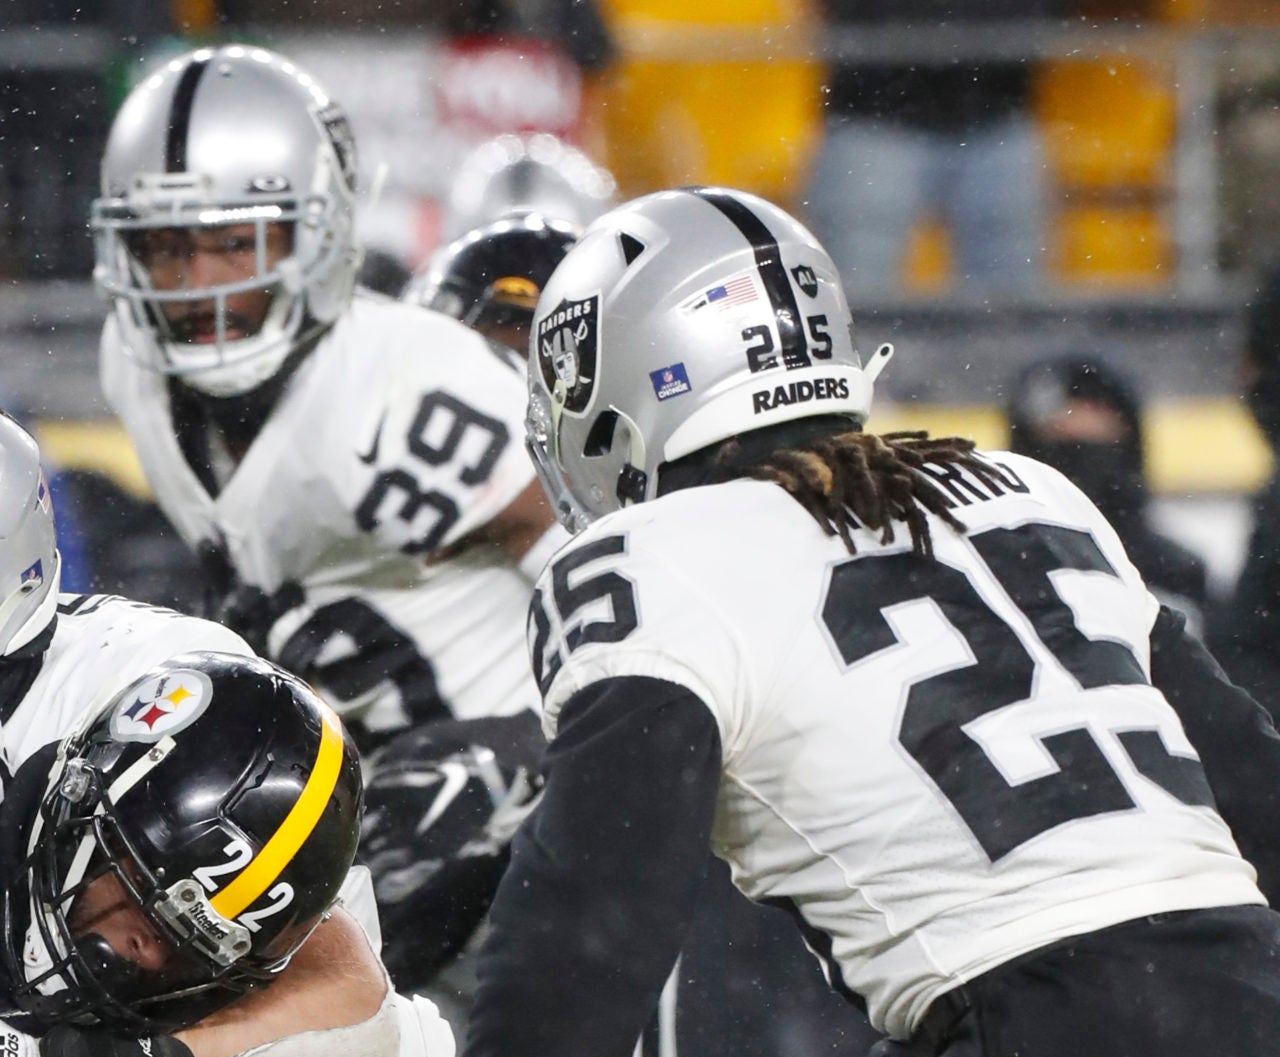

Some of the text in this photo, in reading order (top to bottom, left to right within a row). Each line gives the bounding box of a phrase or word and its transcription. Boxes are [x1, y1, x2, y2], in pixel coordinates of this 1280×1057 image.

[798, 266, 817, 287] AL
[539, 300, 593, 335] RAIDERS
[752, 377, 850, 415] RAIDERS
[355, 390, 511, 556] 39
[818, 518, 1218, 866] 25
[188, 901, 228, 940] Steelers
